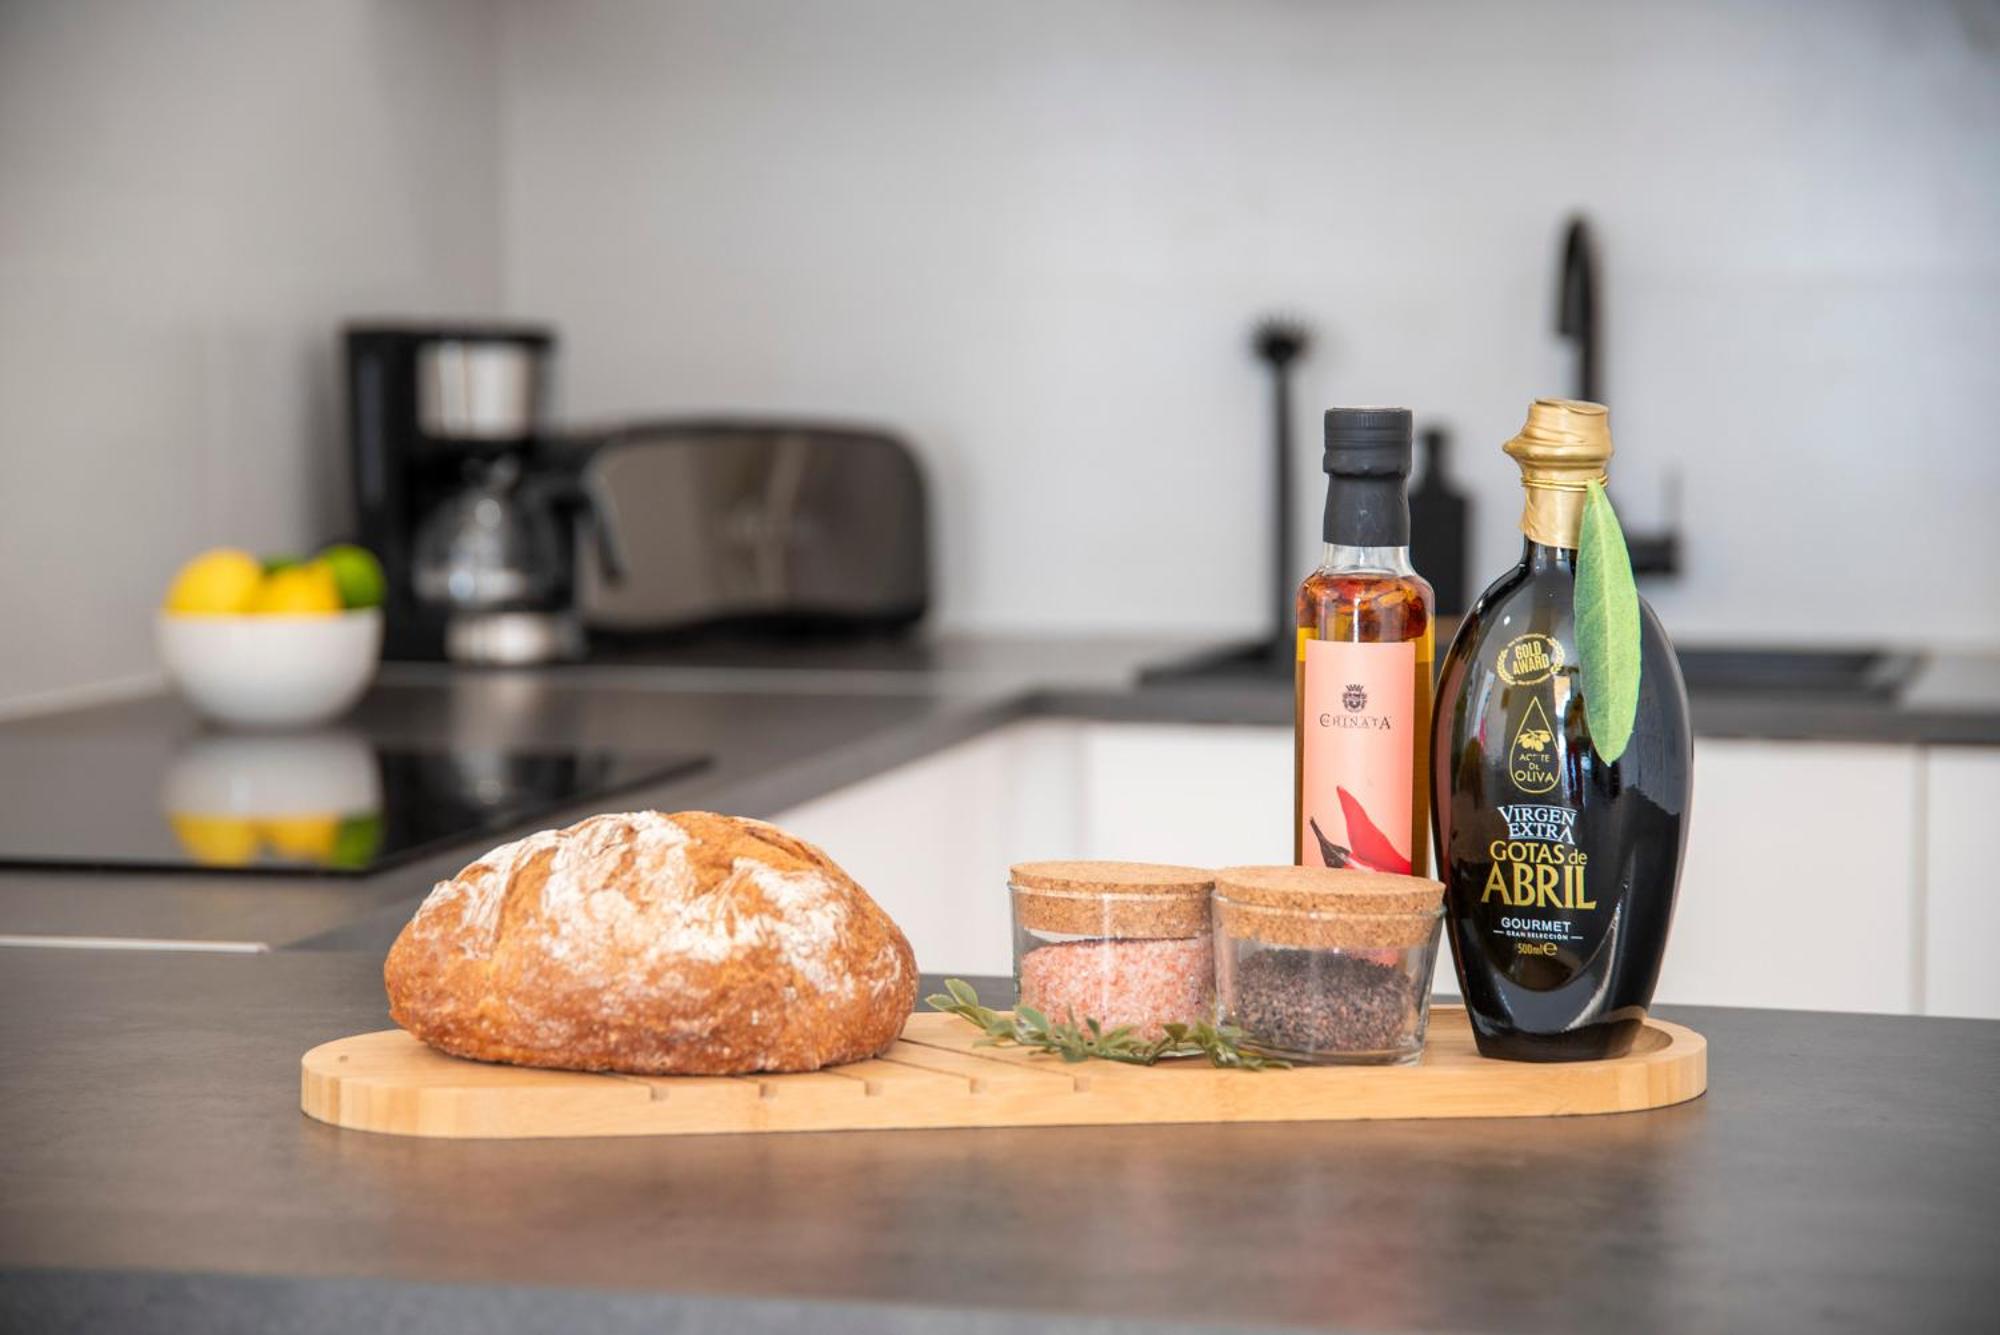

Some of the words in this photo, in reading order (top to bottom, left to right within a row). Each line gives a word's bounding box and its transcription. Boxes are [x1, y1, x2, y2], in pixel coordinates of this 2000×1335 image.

[1515, 641, 1542, 660] GOLD
[1513, 653, 1550, 675] AWARD
[1319, 713, 1392, 730] CHINATA
[1514, 770, 1554, 783] OLIVA
[1497, 804, 1577, 827] VIRGEN
[1508, 822, 1575, 846] EXTRA
[1489, 840, 1565, 865] GOTAS
[1568, 848, 1588, 865] de
[1481, 860, 1597, 910] ABRIL
[1501, 917, 1571, 932] GOURMET
